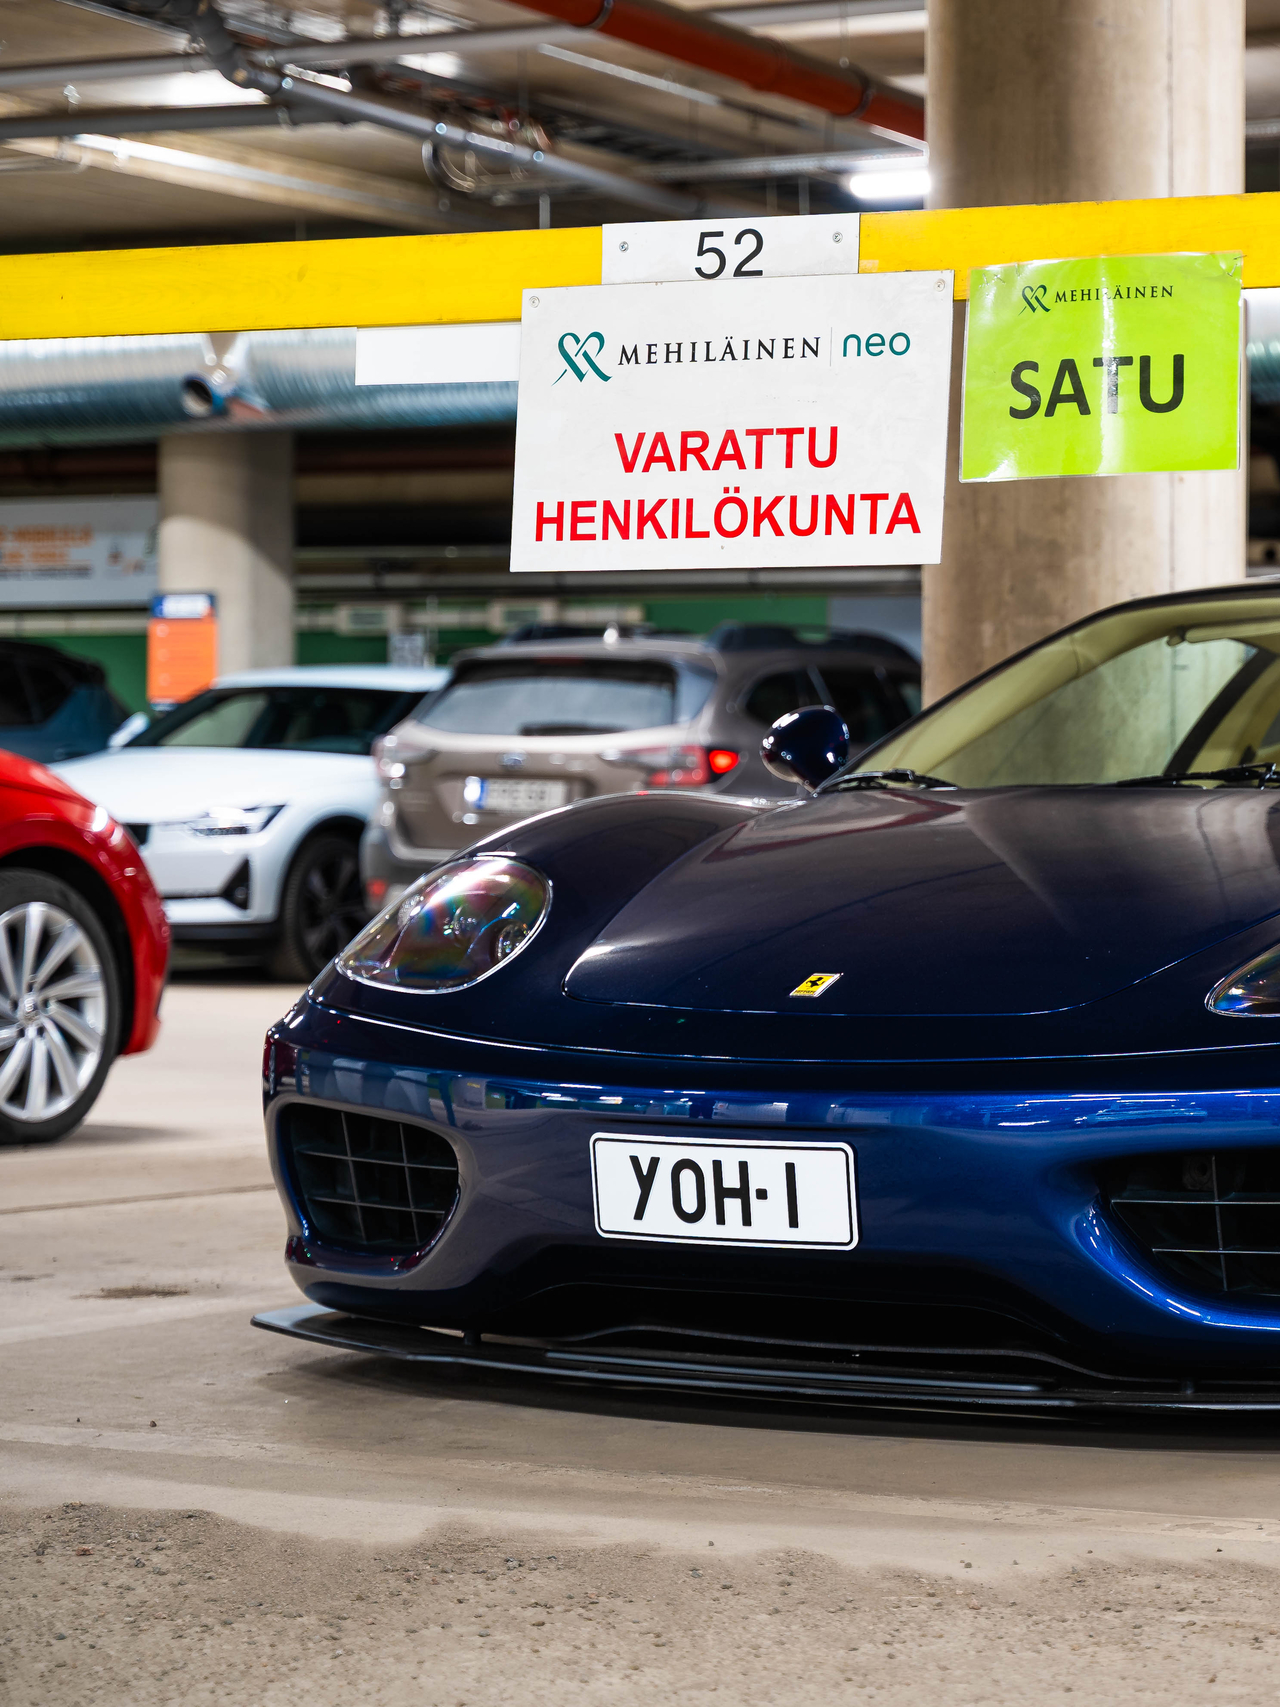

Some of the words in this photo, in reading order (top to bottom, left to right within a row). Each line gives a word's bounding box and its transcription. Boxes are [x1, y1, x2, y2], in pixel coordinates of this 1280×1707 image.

[695, 229, 764, 279] 52
[617, 335, 821, 366] MEHILÄINEN
[842, 331, 911, 358] neo
[1009, 353, 1185, 420] SATU
[614, 426, 839, 474] VARATTU
[535, 487, 921, 542] HENKILÖKUNTA
